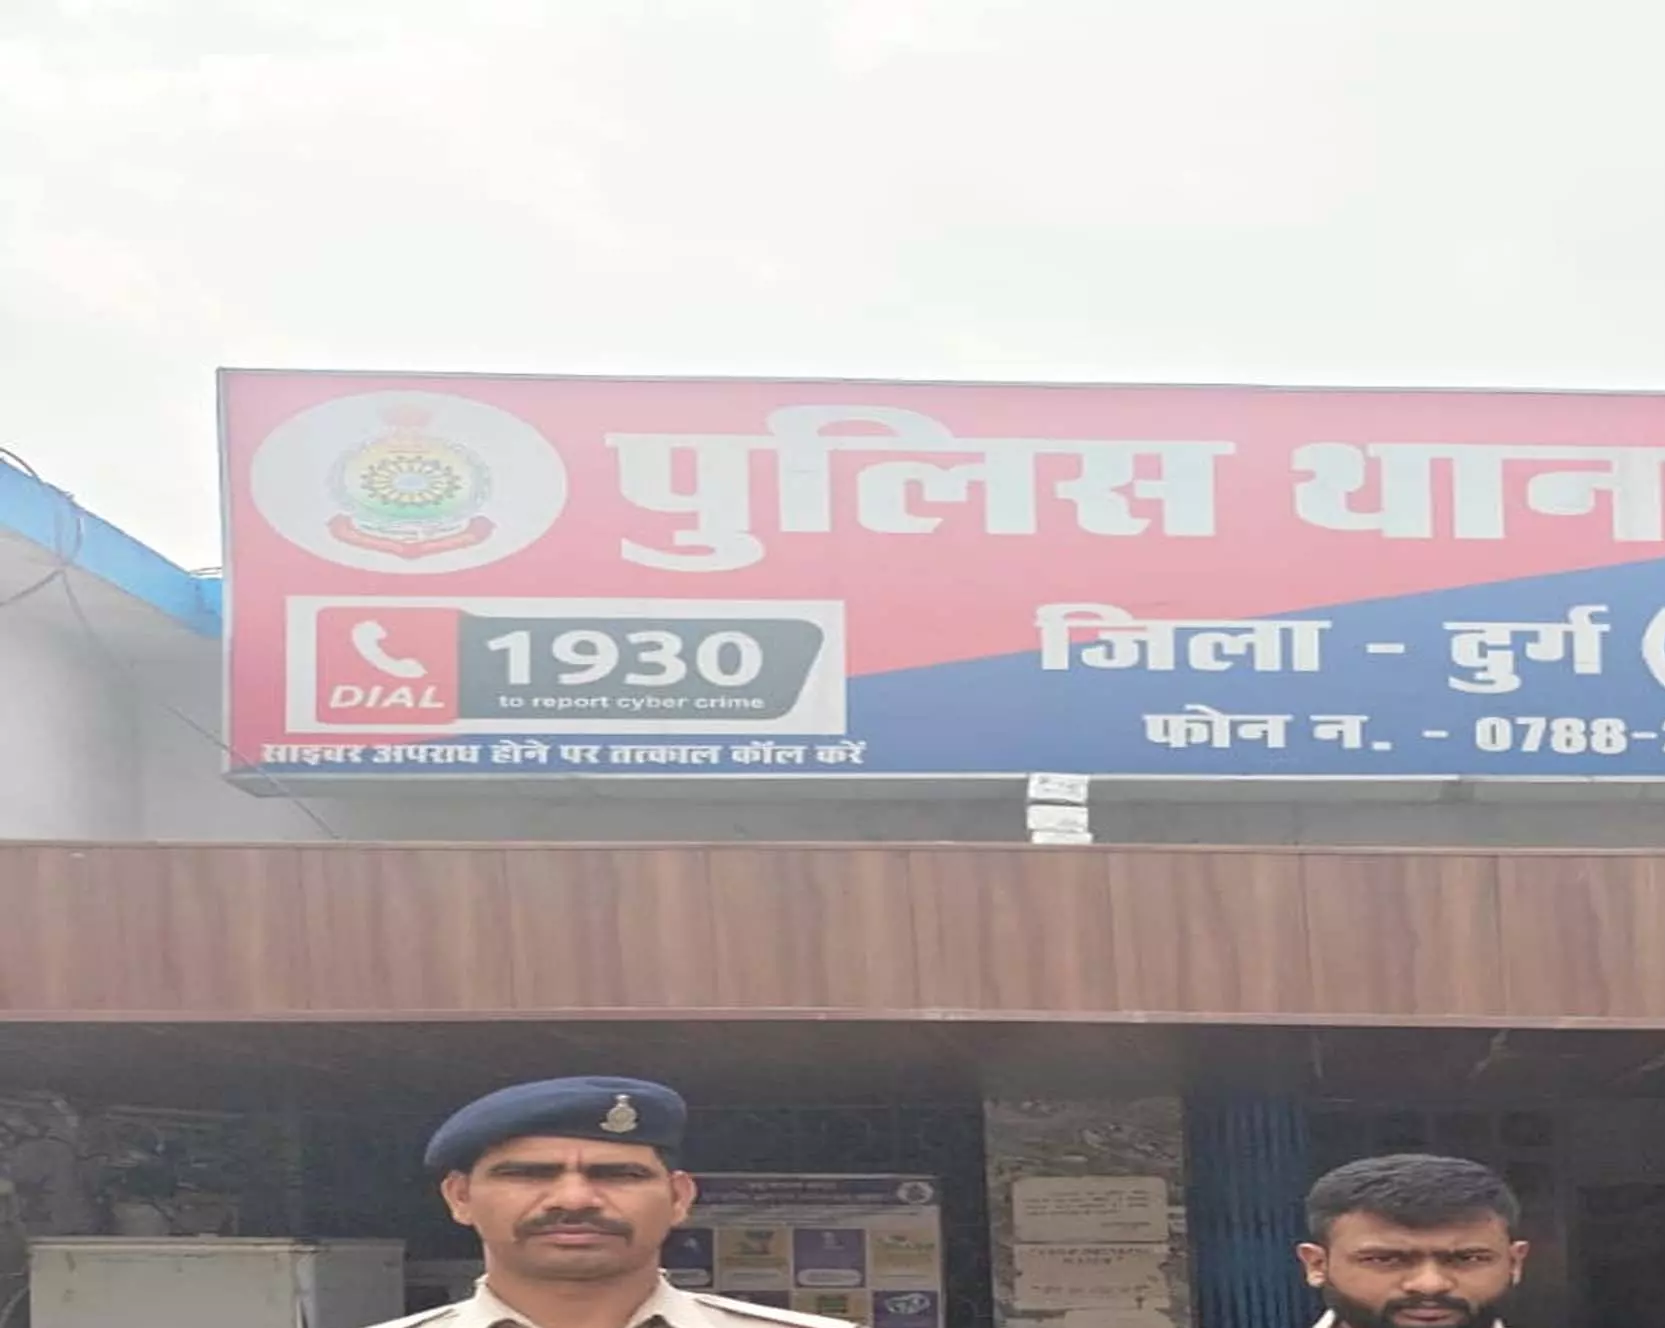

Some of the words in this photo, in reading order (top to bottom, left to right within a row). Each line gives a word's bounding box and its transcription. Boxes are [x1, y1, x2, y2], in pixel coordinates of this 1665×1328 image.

[604, 404, 1237, 573] पुलिस
[487, 629, 764, 687] 1930
[1036, 603, 1332, 673] जिला
[1443, 604, 1611, 694] दुर्ग
[329, 684, 446, 708] DIAL
[499, 696, 524, 708] to
[532, 696, 610, 712] report
[616, 696, 687, 711] cyber
[694, 697, 766, 709] crime
[1143, 704, 1292, 749] फोन
[1309, 713, 1392, 751] न.
[262, 743, 365, 765] साइबर
[372, 744, 480, 764] अपराध
[491, 739, 552, 764] होने
[560, 744, 601, 764] पर
[609, 744, 723, 764] तत्काल
[731, 740, 805, 764] कॉल
[815, 740, 867, 764] करें
